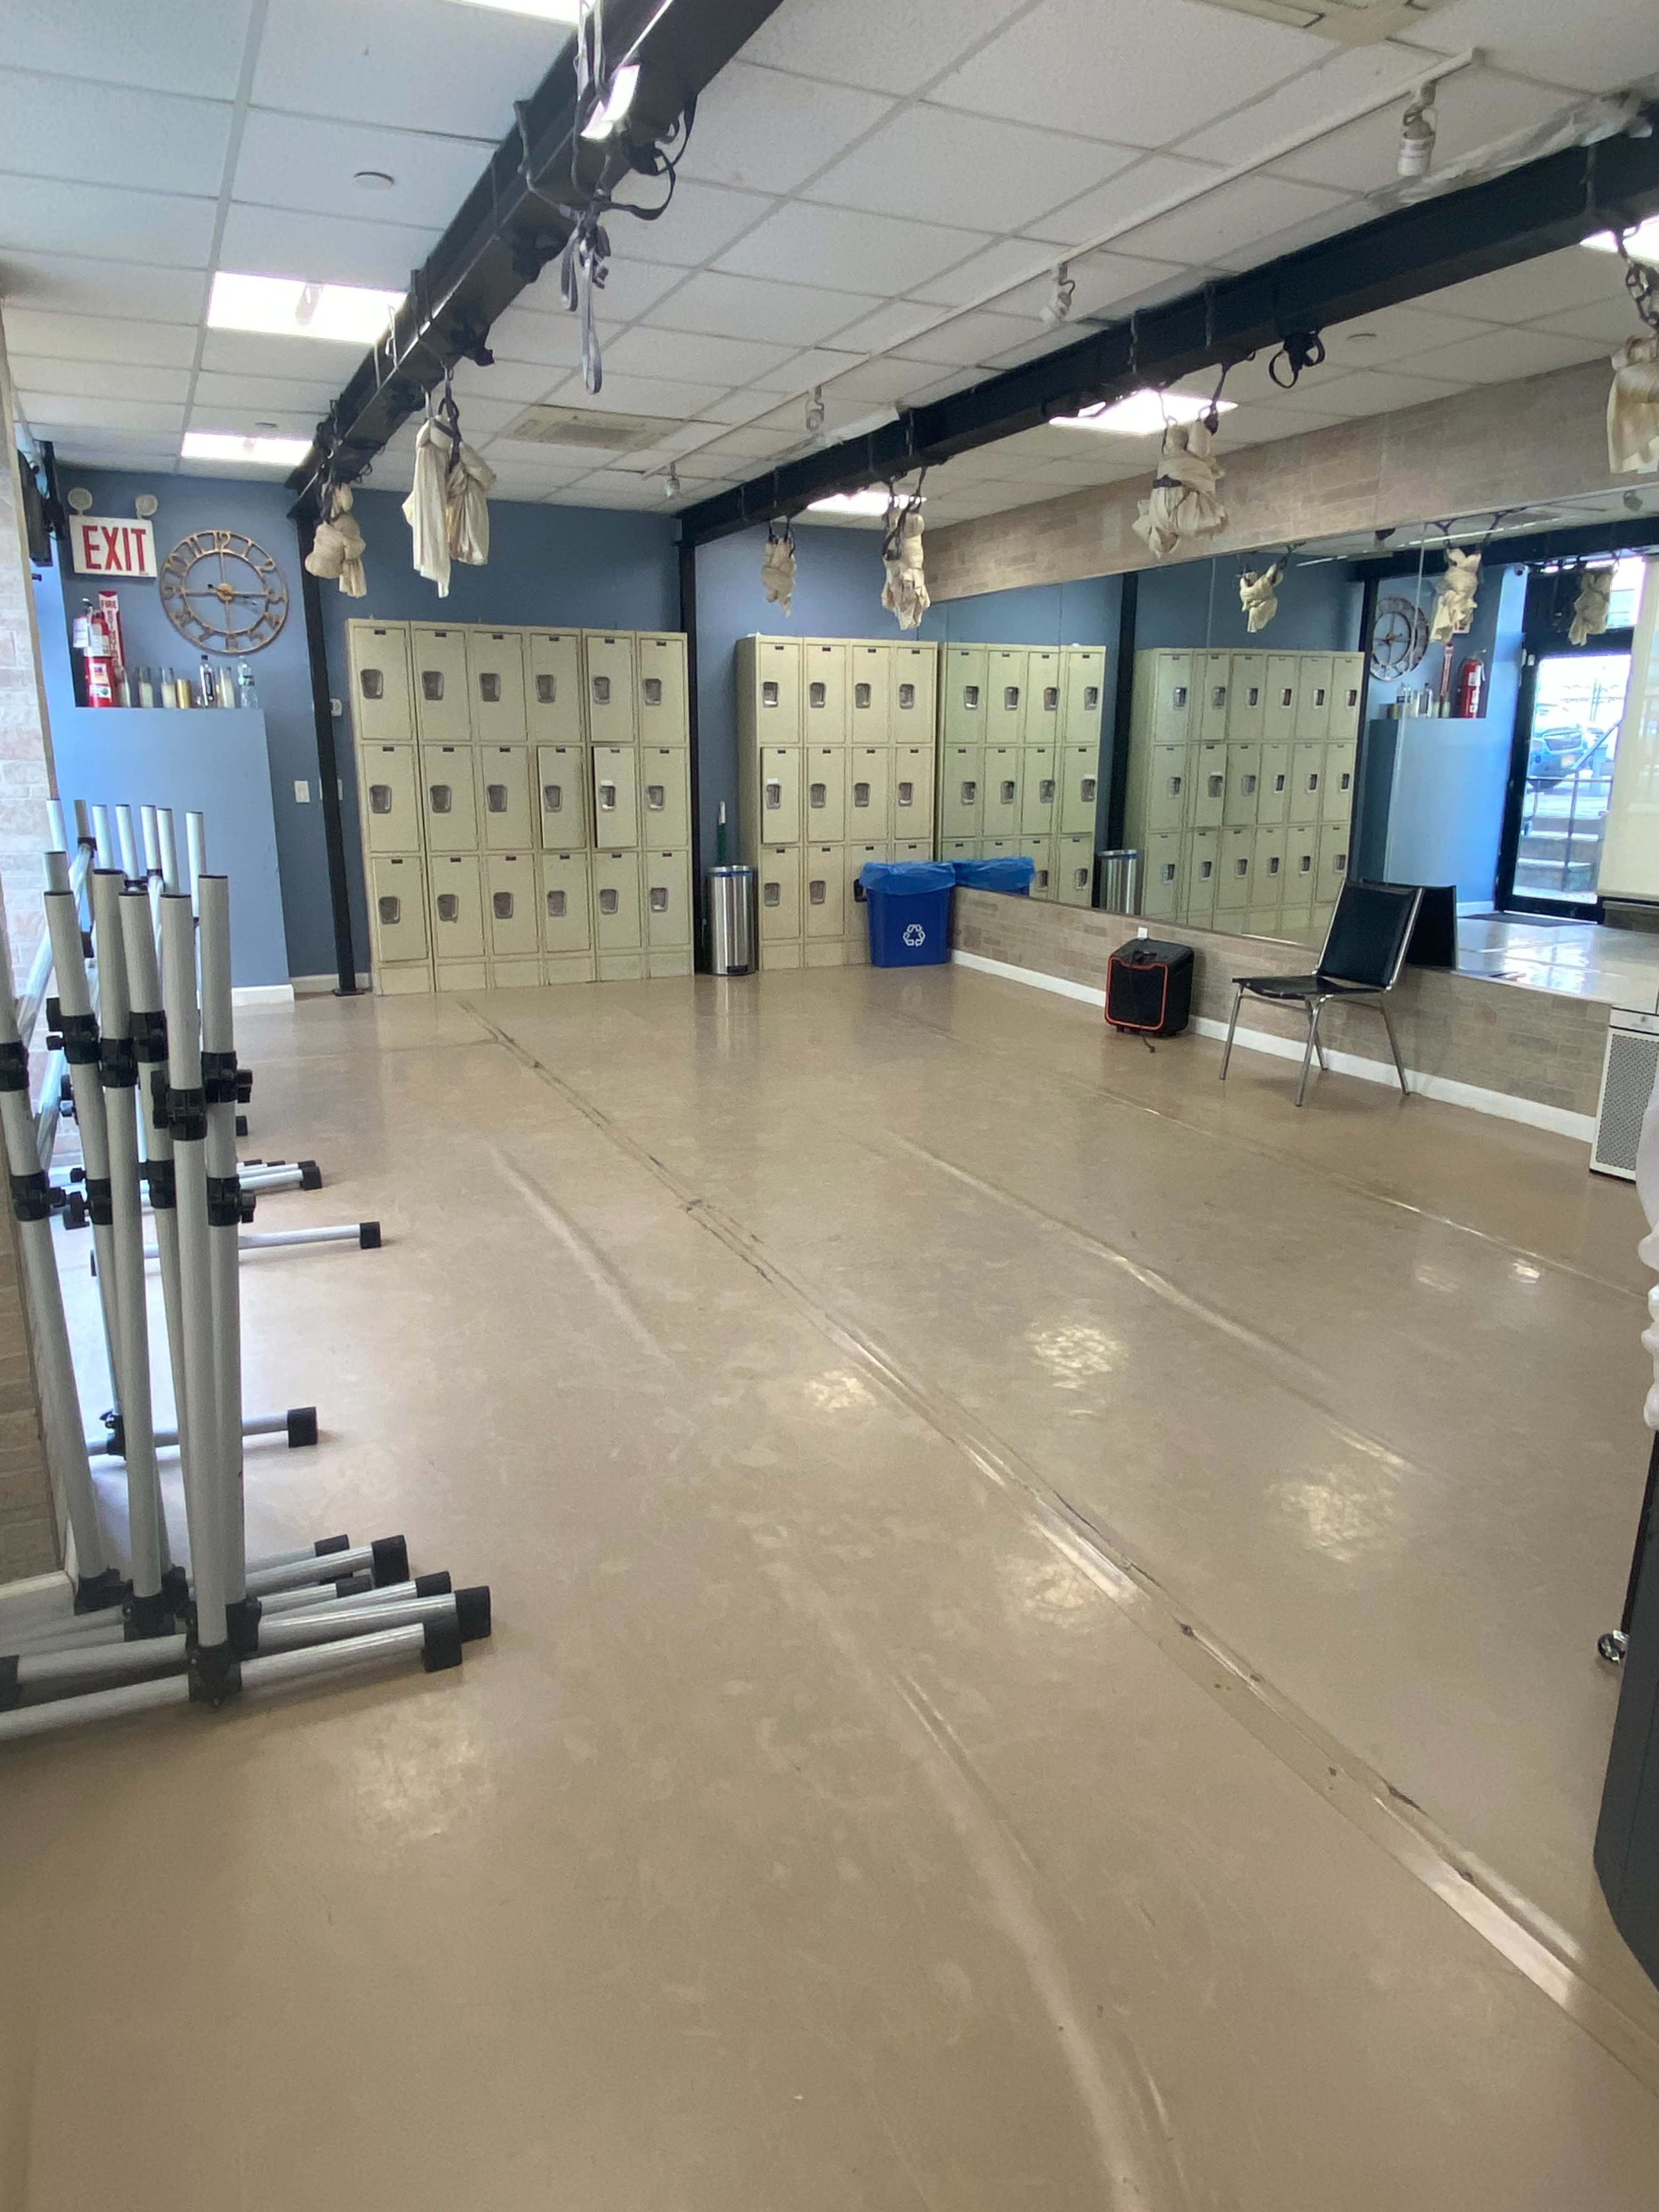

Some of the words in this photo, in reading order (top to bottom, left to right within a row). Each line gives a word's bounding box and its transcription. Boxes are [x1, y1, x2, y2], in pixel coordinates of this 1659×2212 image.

[82, 525, 146, 572] EXIT
[213, 531, 231, 552] 12
[100, 600, 117, 609] FIRE
